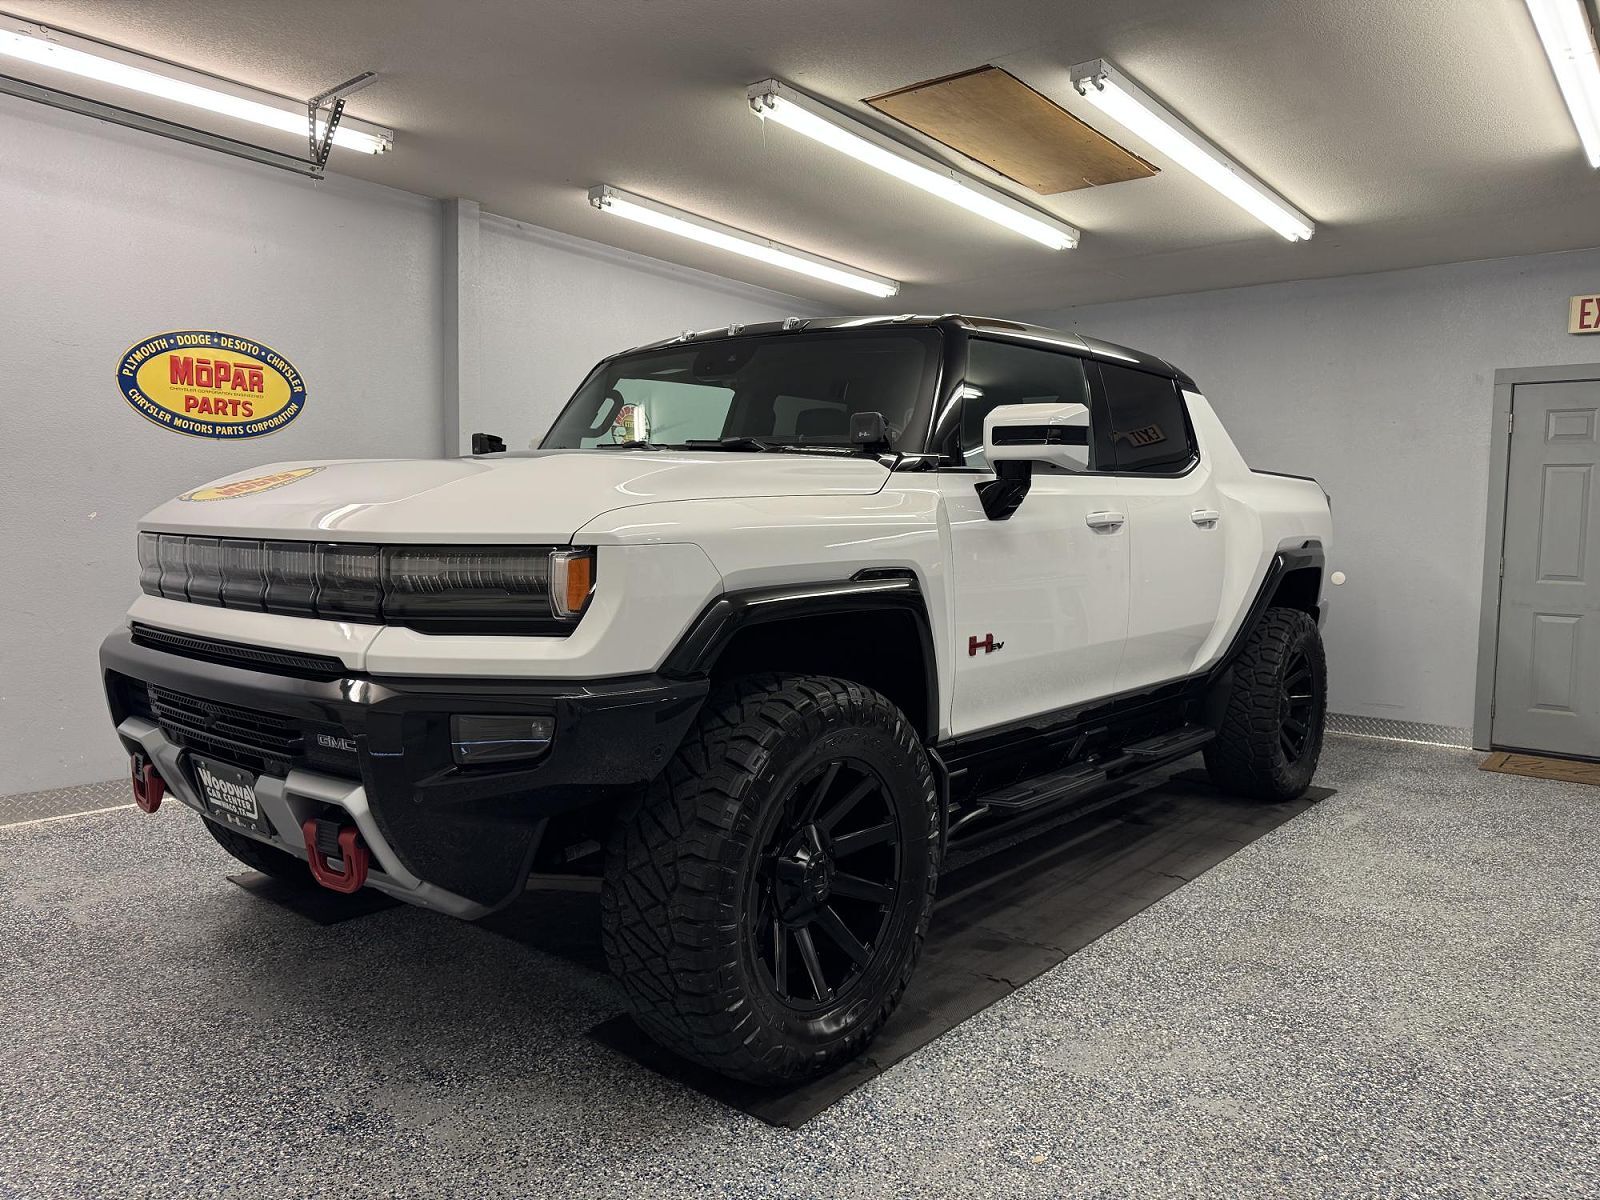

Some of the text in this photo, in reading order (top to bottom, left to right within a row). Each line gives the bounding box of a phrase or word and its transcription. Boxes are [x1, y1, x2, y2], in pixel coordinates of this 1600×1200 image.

[122, 334, 303, 393] PLYMOUTH DODGE DESOTO CHRYSLER
[128, 388, 299, 436] CHRYSLER MOTORS PARTS CORPORATION
[184, 395, 254, 417] PARTS
[317, 734, 357, 752] GMC
[197, 767, 257, 804] WOODWAY
[206, 787, 253, 811] CAR CENTER
